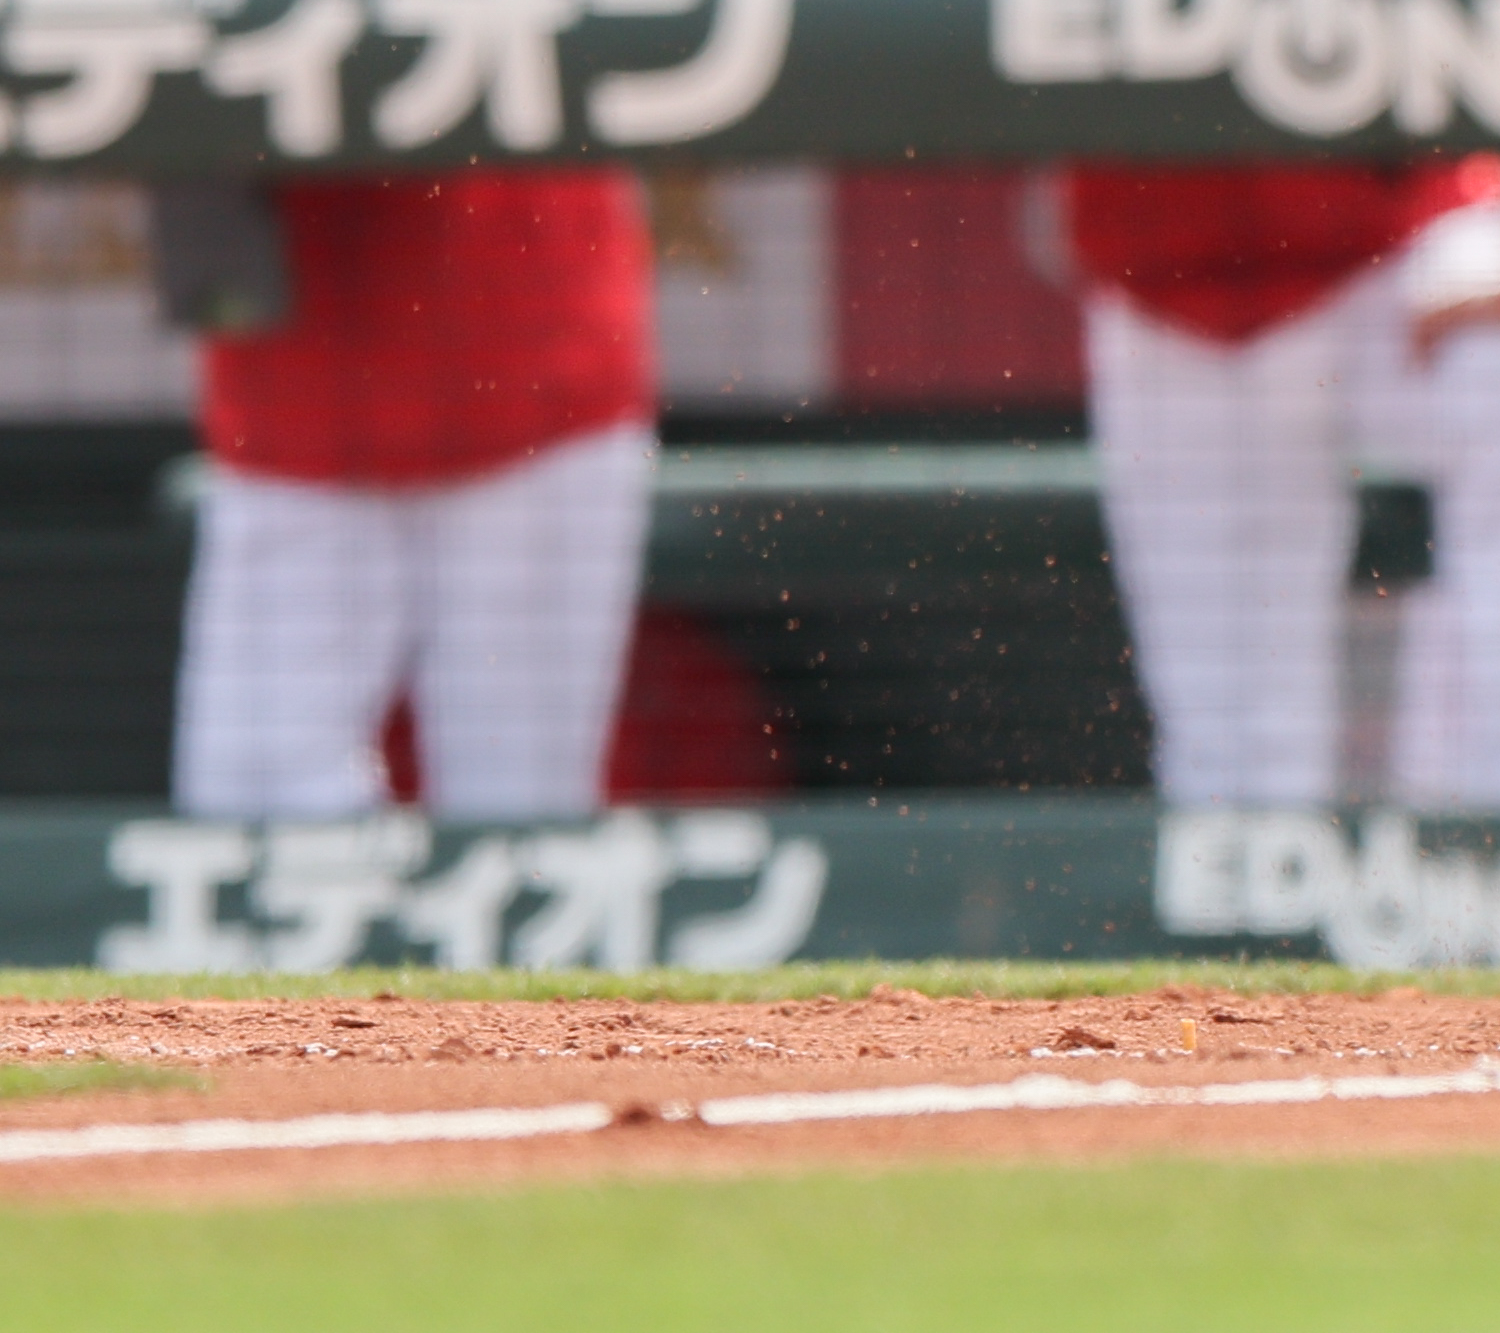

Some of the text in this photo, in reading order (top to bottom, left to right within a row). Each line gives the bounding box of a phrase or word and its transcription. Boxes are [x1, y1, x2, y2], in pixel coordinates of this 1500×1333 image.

[95, 807, 829, 972] エディオン
